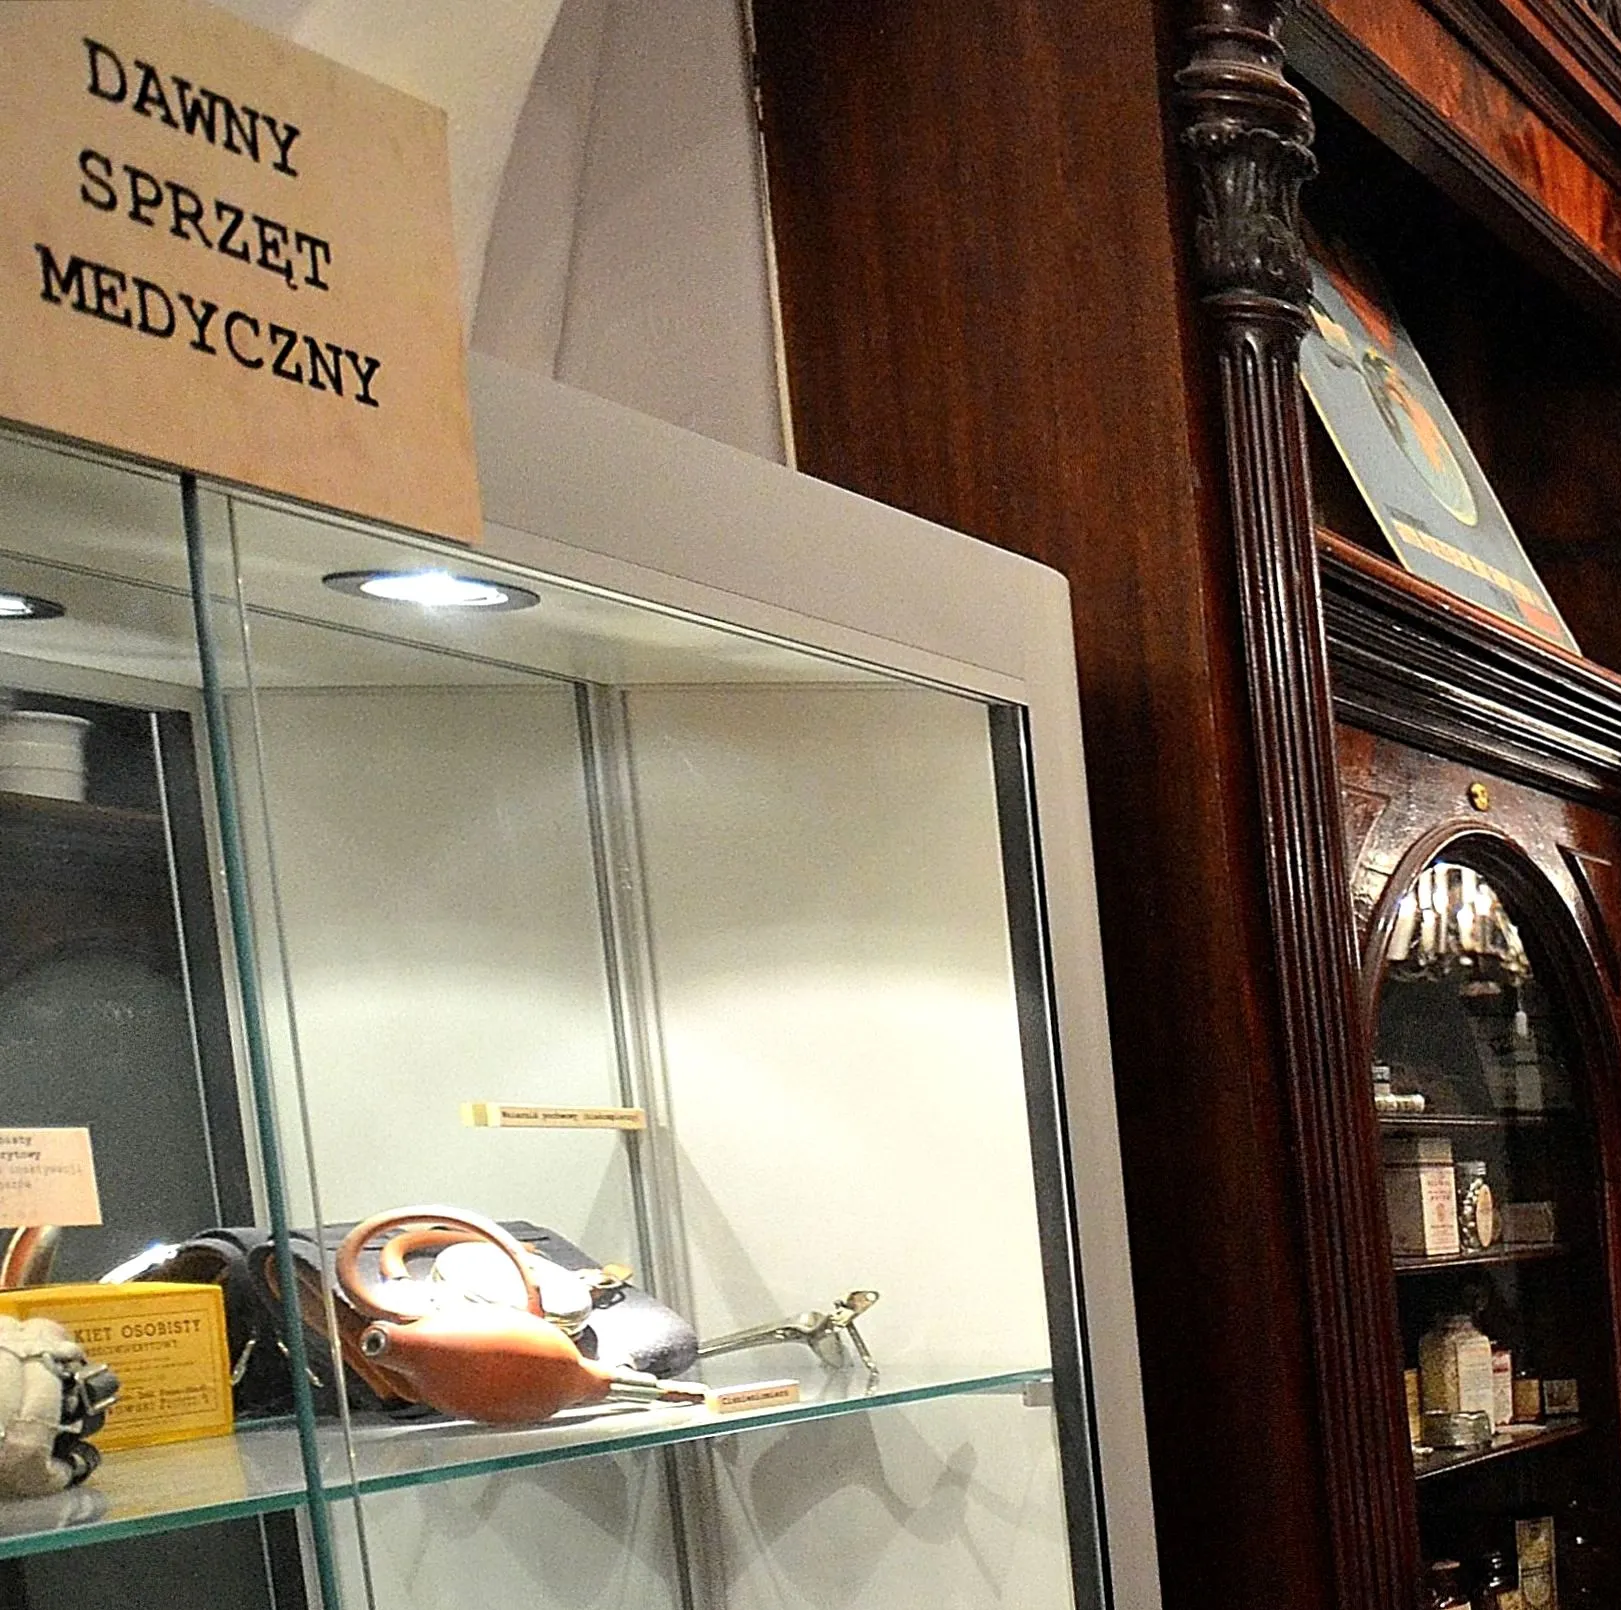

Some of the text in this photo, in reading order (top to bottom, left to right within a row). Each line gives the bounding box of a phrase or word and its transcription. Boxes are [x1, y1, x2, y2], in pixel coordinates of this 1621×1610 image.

[82, 37, 300, 177] DAWNY
[79, 148, 331, 291] SPRZĘT
[34, 243, 381, 407] MEDYCZNY
[73, 1318, 200, 1344] KIET OSOBISTY
